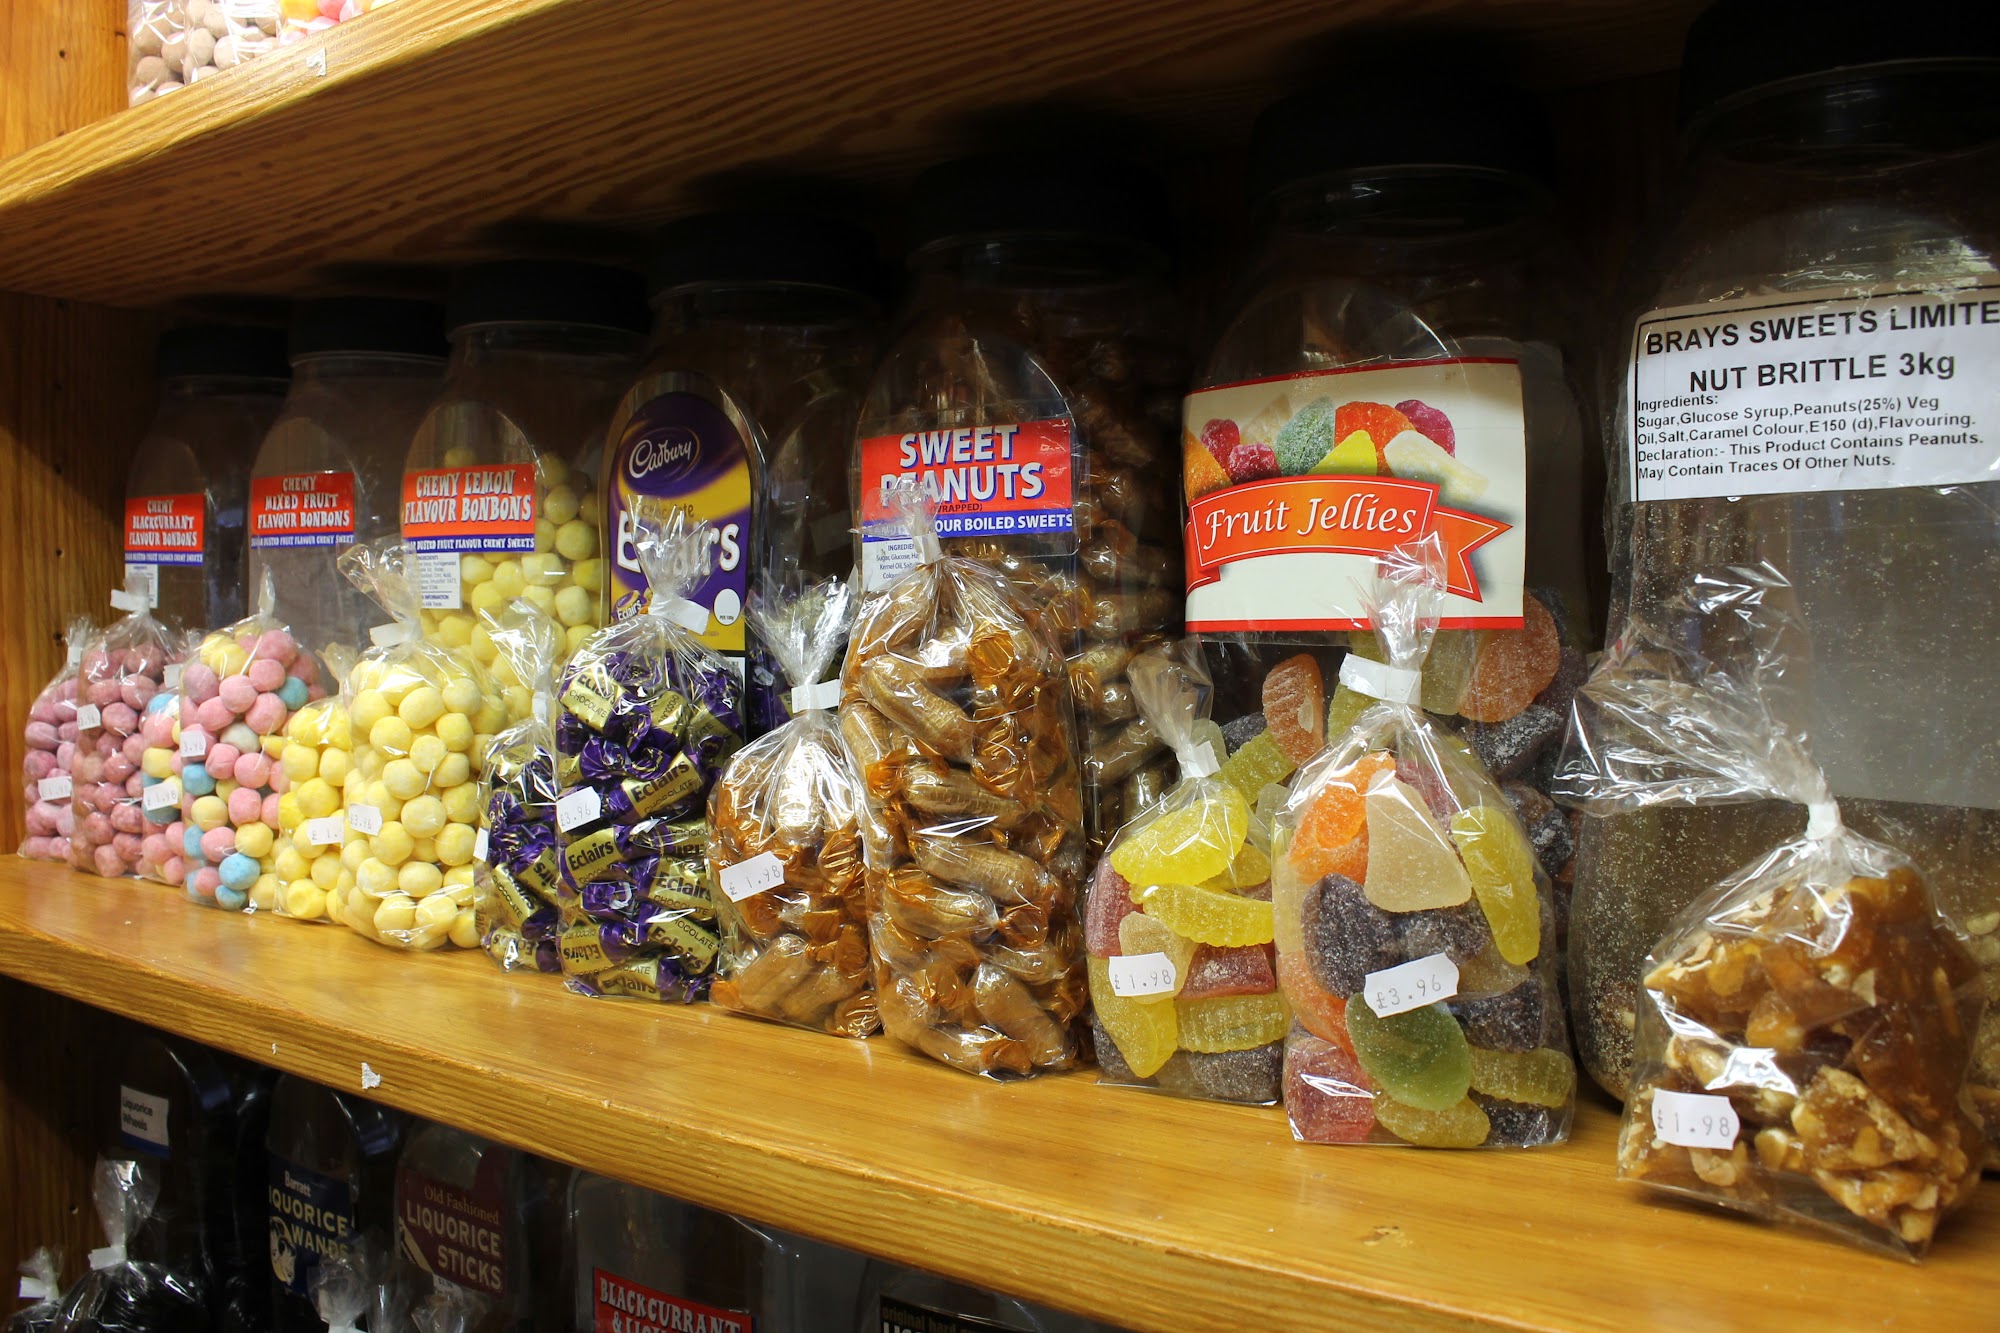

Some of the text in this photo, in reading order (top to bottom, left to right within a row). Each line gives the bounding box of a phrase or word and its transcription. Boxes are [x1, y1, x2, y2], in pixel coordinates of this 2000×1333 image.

[1647, 301, 2000, 355] BRAYS SWEETS LIMITE
[1690, 351, 1955, 393] NUT BRITTLE 3kg
[1637, 394, 1719, 412] Ingredients:
[1637, 396, 1939, 430] Sugar,Glucose Syrup,Peanuts(25%) Veg
[1637, 413, 1976, 446] Oil,Salt,Caramel Colour,E150 (d),Flavouring.
[1729, 442, 1761, 456] This
[1765, 439, 1825, 453] Product
[1830, 434, 1903, 450] Contains
[1908, 431, 1984, 446] Peanuts.
[628, 438, 692, 478] Cadbury
[899, 424, 1019, 469] SWEET
[1638, 453, 1895, 481] May Contain Traces Of Other Nuts.
[282, 476, 316, 492] CHEWY
[416, 470, 516, 498] CHEWY LEMON
[880, 462, 1046, 508] PEANUTS
[147, 499, 173, 514] CHEWY
[265, 492, 338, 511] MIXED FRUIT
[404, 494, 532, 524] FLAVOUR BONBONS
[132, 514, 195, 530] BLACKCURRANT
[258, 510, 350, 529] FLAVOUR BONBONS
[964, 516, 1015, 531] BOILED
[1017, 513, 1073, 528] SWEETS
[1203, 493, 1417, 550] Fruit Jellies
[129, 531, 198, 547] FLAVOUR BONBONS
[437, 539, 454, 550] FRUIT
[455, 538, 481, 549] FLAVOUR
[483, 538, 506, 549] CHEWY
[507, 537, 535, 548] SWEETS
[569, 688, 608, 719] CHOCOLATE
[630, 759, 690, 803] Eclairs
[559, 804, 592, 827] £3.96
[567, 840, 615, 872] Eclairs
[728, 864, 781, 896] £1.98
[1113, 968, 1173, 990] £1.98
[1375, 973, 1443, 1010] £3.96
[1656, 1108, 1730, 1138] £1.98
[269, 1185, 348, 1237] IQUORICE
[424, 1185, 499, 1225] Old Fashioned
[406, 1199, 501, 1258] LIQUORICE
[437, 1244, 503, 1291] STICKS
[599, 1276, 741, 1333] BLACKCURRANT
